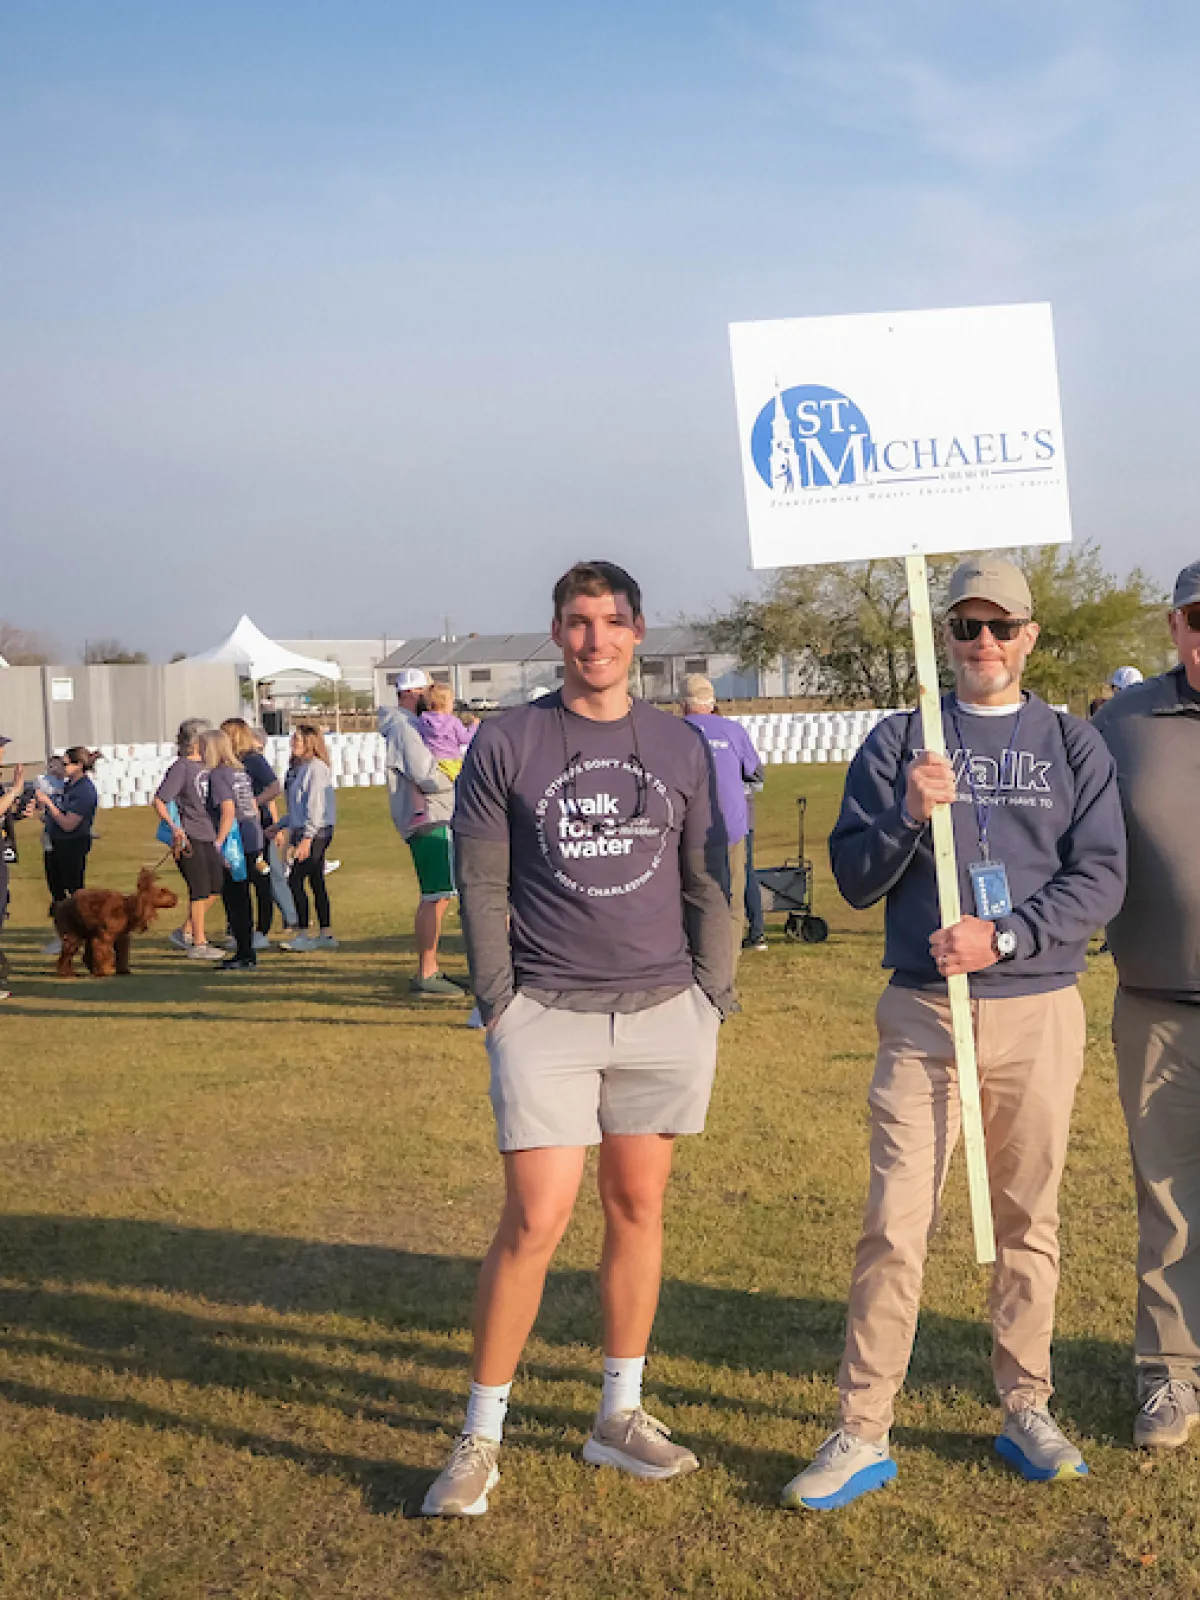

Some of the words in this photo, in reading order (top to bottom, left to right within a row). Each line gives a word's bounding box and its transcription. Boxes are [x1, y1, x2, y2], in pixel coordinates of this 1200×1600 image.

[796, 397, 857, 436] ST.
[800, 429, 1056, 490] MICHAEL'S
[558, 793, 619, 815] walk
[558, 836, 635, 859] water
